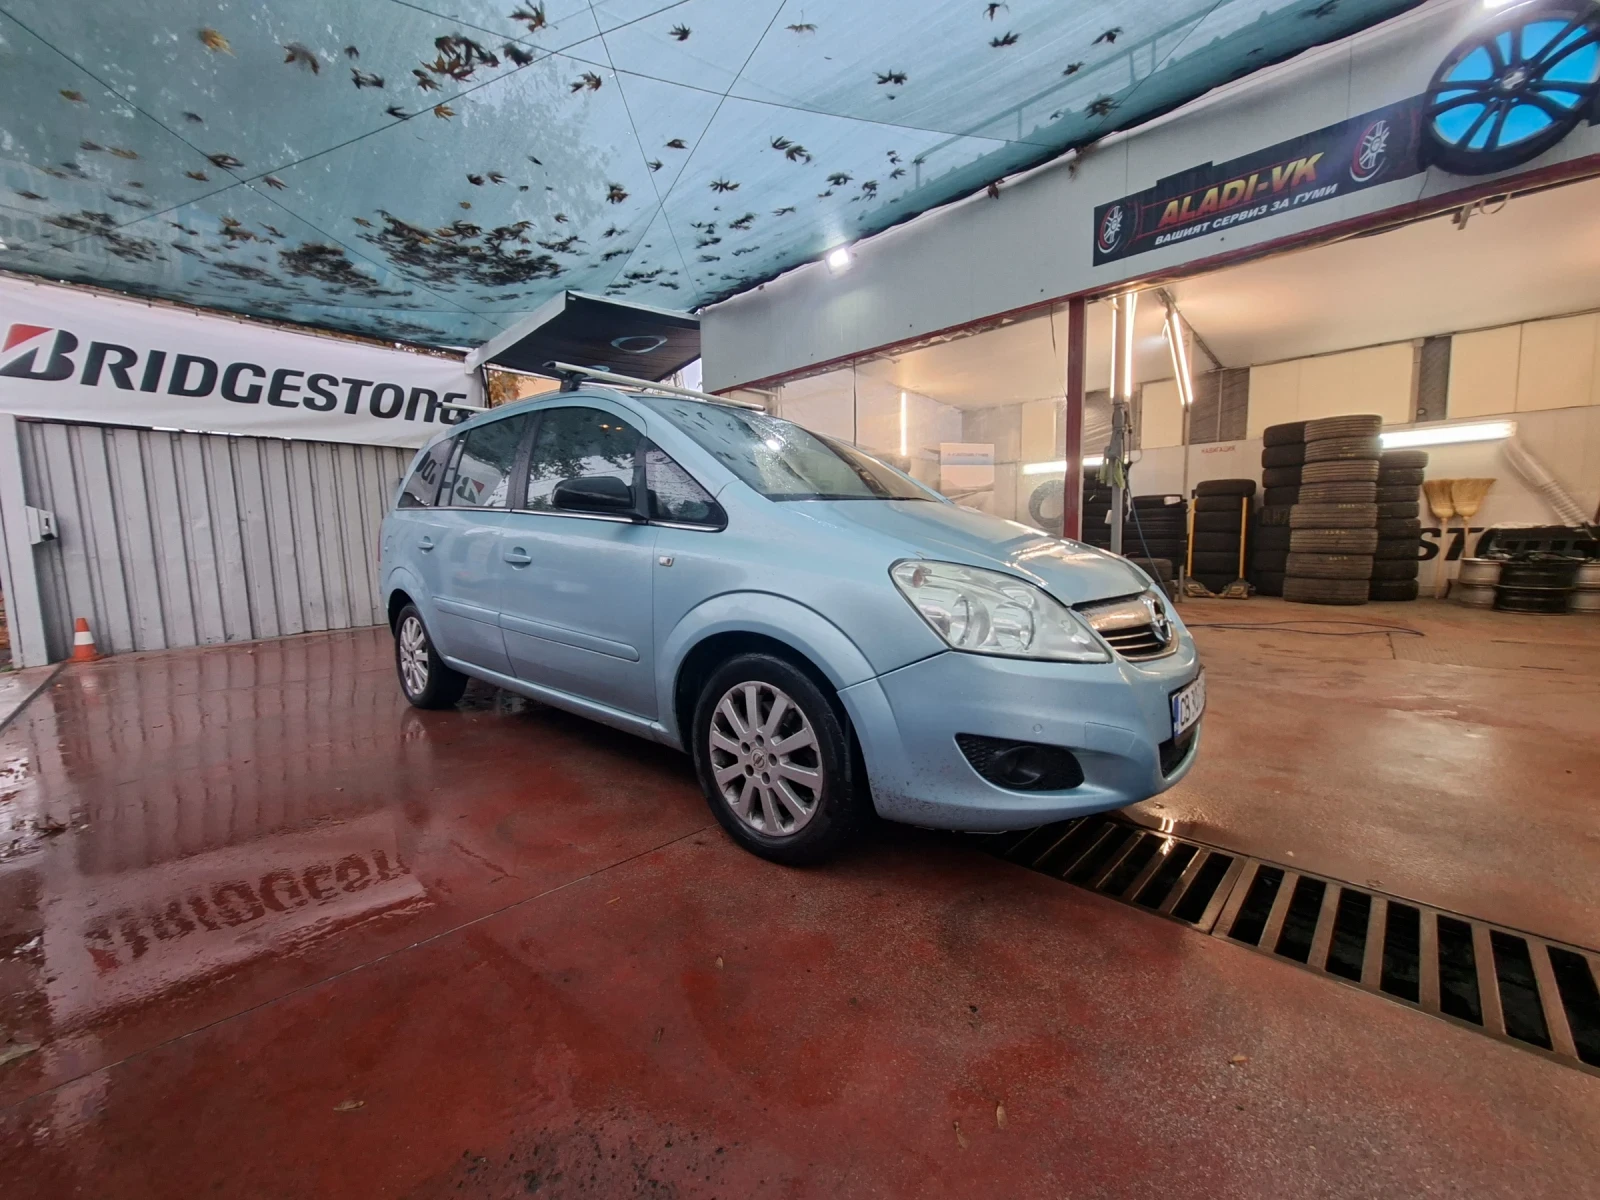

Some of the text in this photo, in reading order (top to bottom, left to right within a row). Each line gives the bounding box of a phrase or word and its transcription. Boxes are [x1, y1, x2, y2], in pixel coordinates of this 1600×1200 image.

[1155, 183, 1339, 245] ВАШИЯТ СЕРВИЗ ЗА ГУМИ
[1157, 152, 1325, 228] ALADI-VK
[0, 323, 467, 426] BRIDGESTONE
